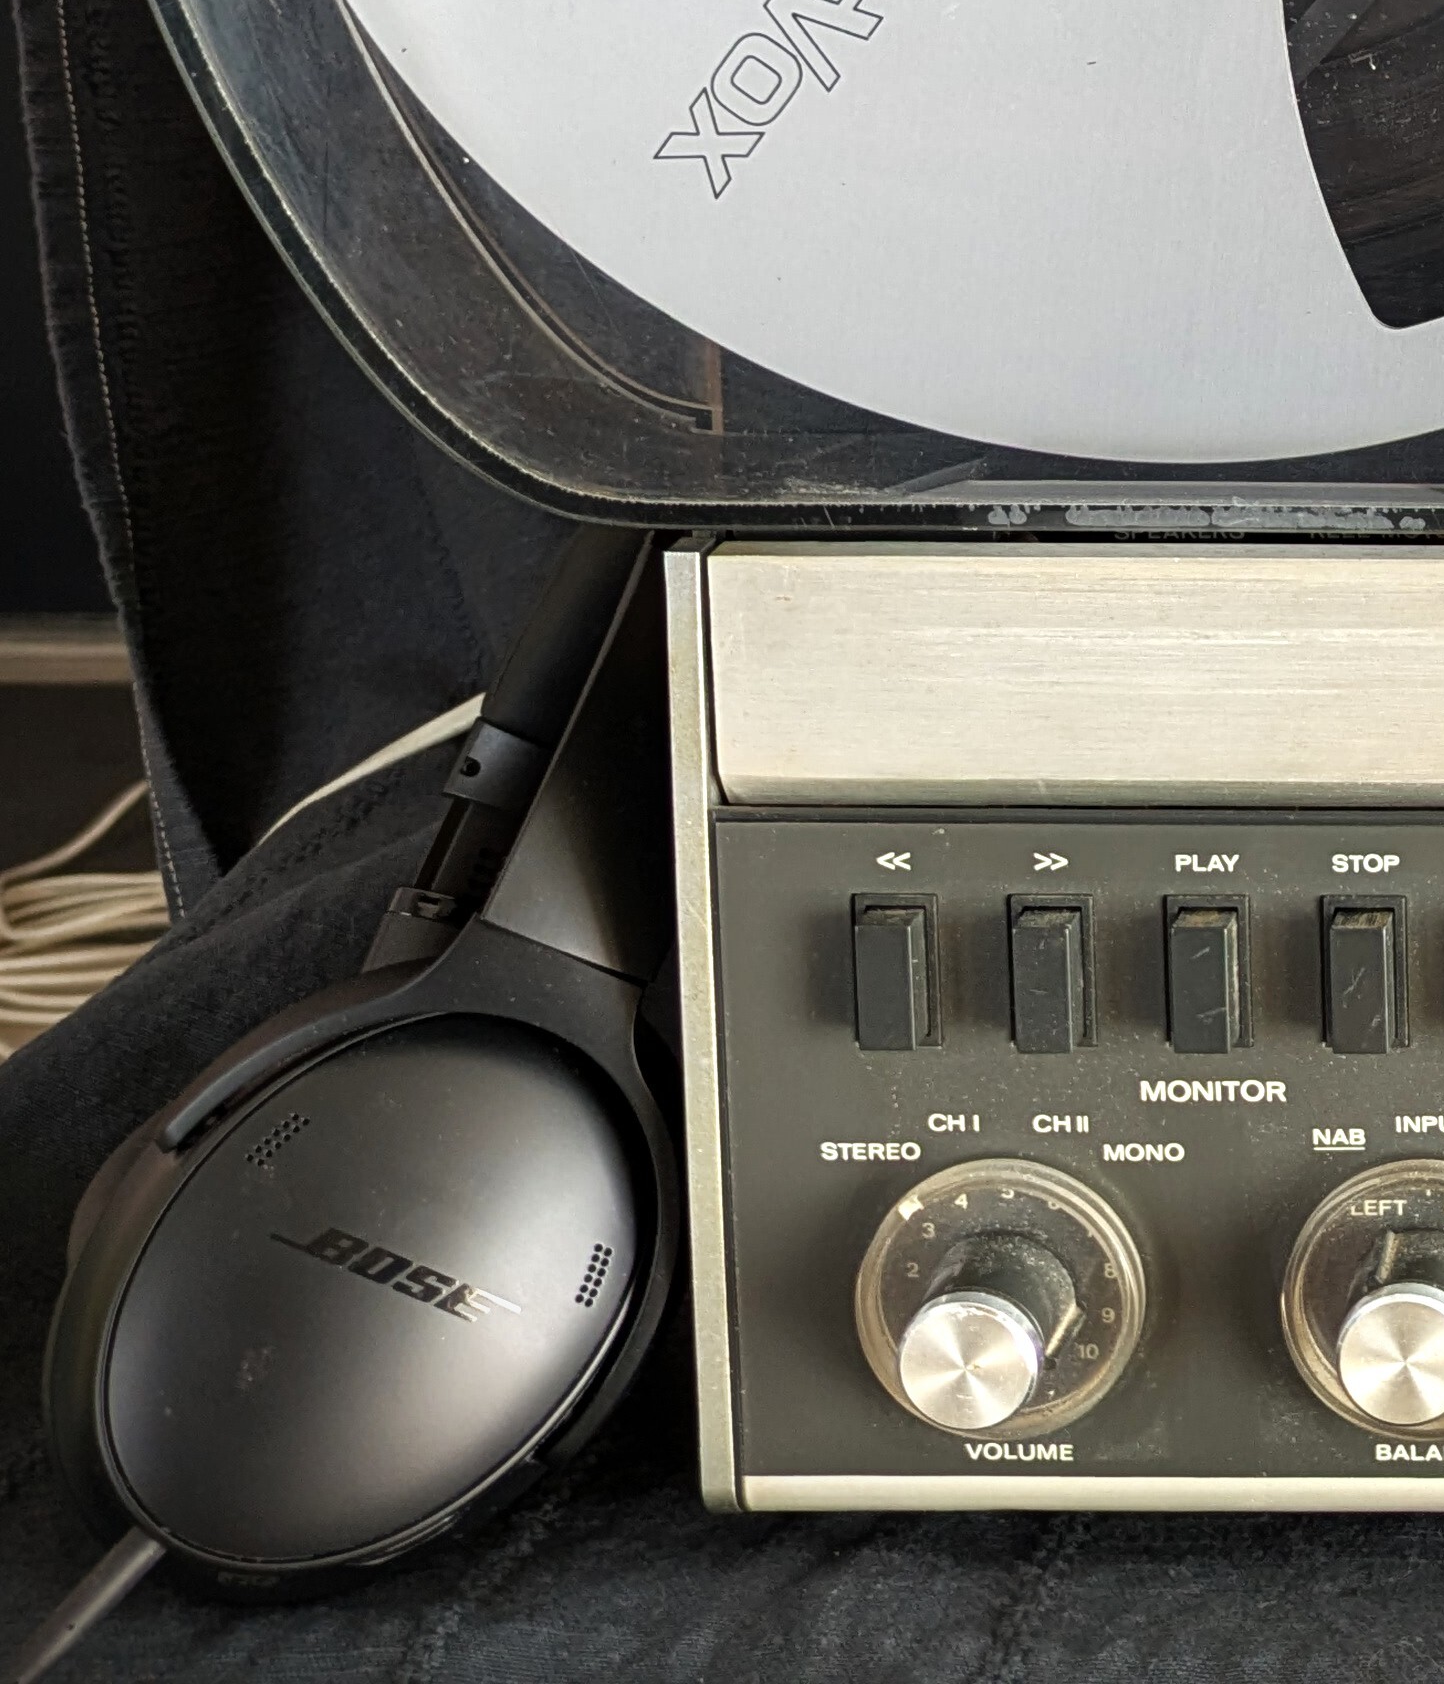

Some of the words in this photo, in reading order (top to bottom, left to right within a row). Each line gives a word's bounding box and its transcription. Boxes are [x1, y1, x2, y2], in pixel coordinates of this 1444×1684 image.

[1174, 854, 1240, 873] PLAY
[1331, 853, 1400, 873] STOP
[1139, 1079, 1287, 1103] MONITOR
[927, 1113, 966, 1132] CH
[1032, 1114, 1072, 1133] CH
[1312, 1128, 1367, 1151] NAB
[820, 1141, 922, 1161] STEREO
[1102, 1142, 1185, 1162] MONO
[954, 1193, 968, 1209] 4
[1349, 1199, 1408, 1216] LEFT
[921, 1222, 936, 1240] 3
[269, 1227, 522, 1322] BOSE
[907, 1262, 920, 1278] 2
[1102, 1308, 1116, 1324] 9
[1078, 1344, 1099, 1360] 10
[964, 1442, 1074, 1462] VOLUME
